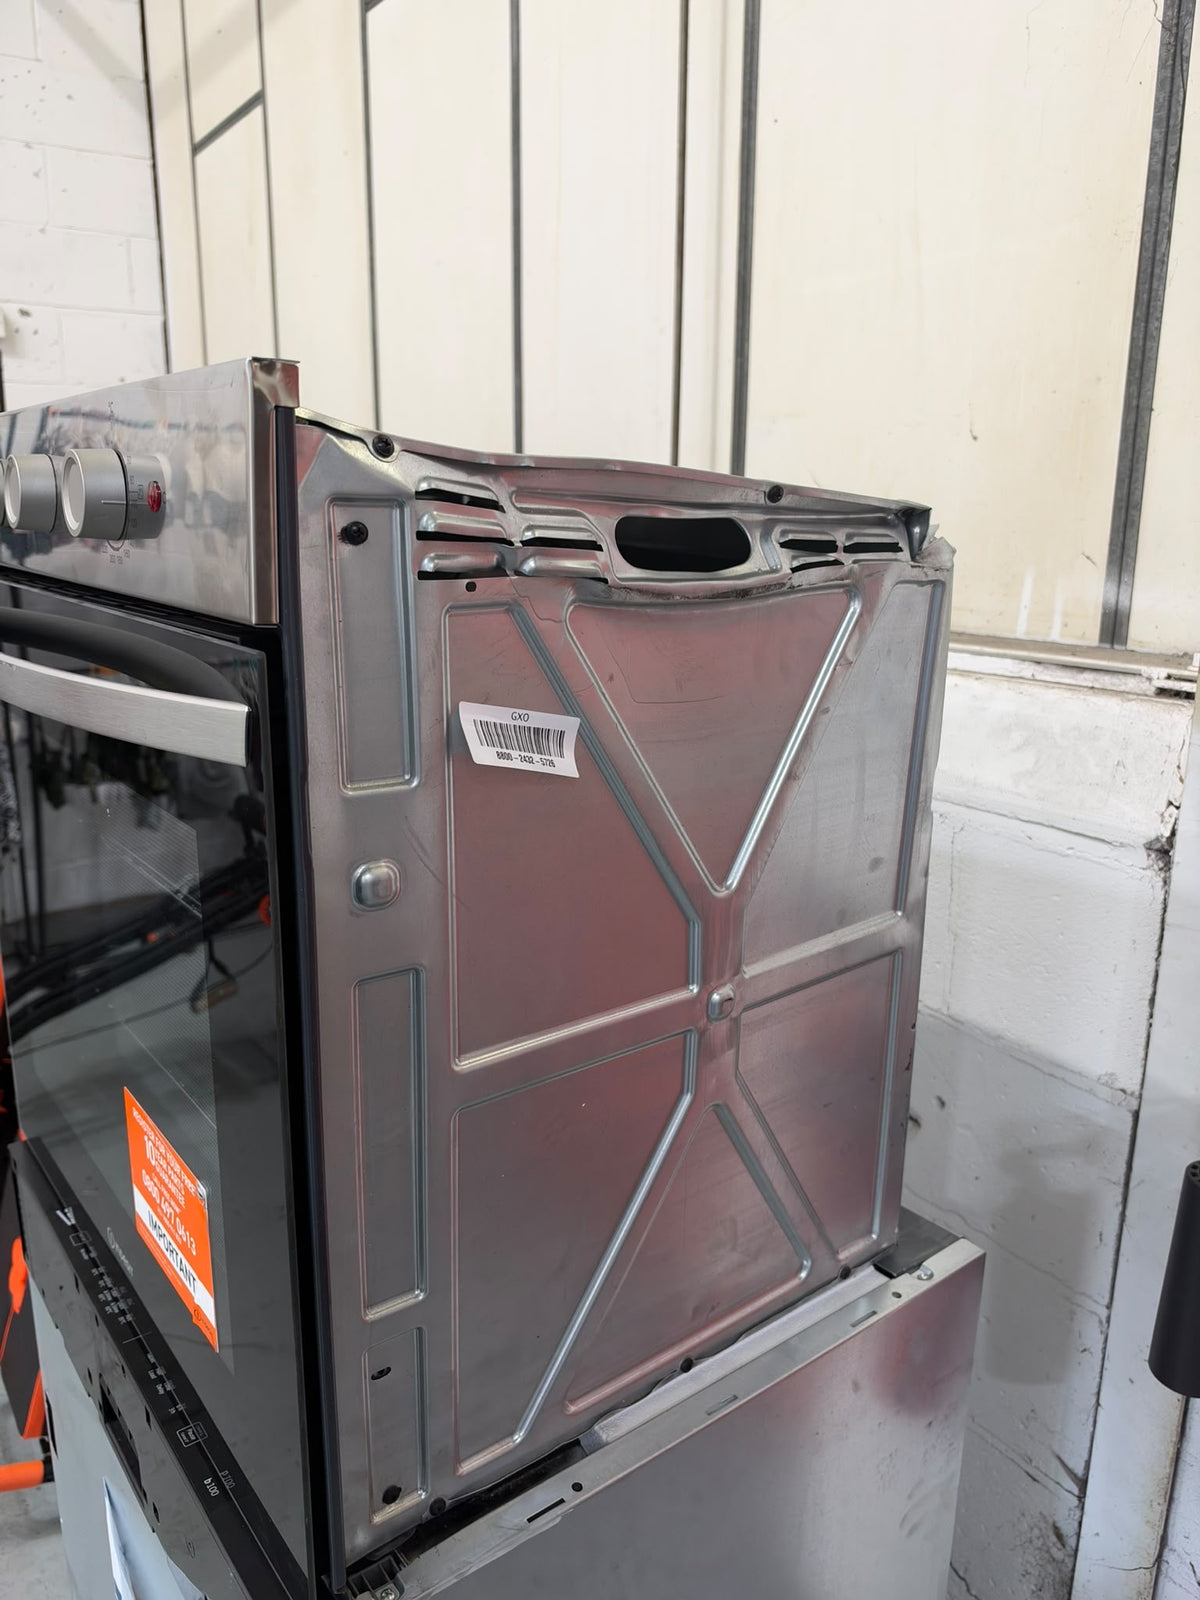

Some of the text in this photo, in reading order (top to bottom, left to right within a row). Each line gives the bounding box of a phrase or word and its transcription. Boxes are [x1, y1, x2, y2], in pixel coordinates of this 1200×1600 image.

[511, 711, 530, 722] GXO
[144, 1134, 156, 1167] 10
[142, 1168, 160, 1205] 0800
[160, 1196, 175, 1225] 497
[176, 1217, 197, 1256] 0613
[147, 1210, 197, 1295] IMPORTANT
